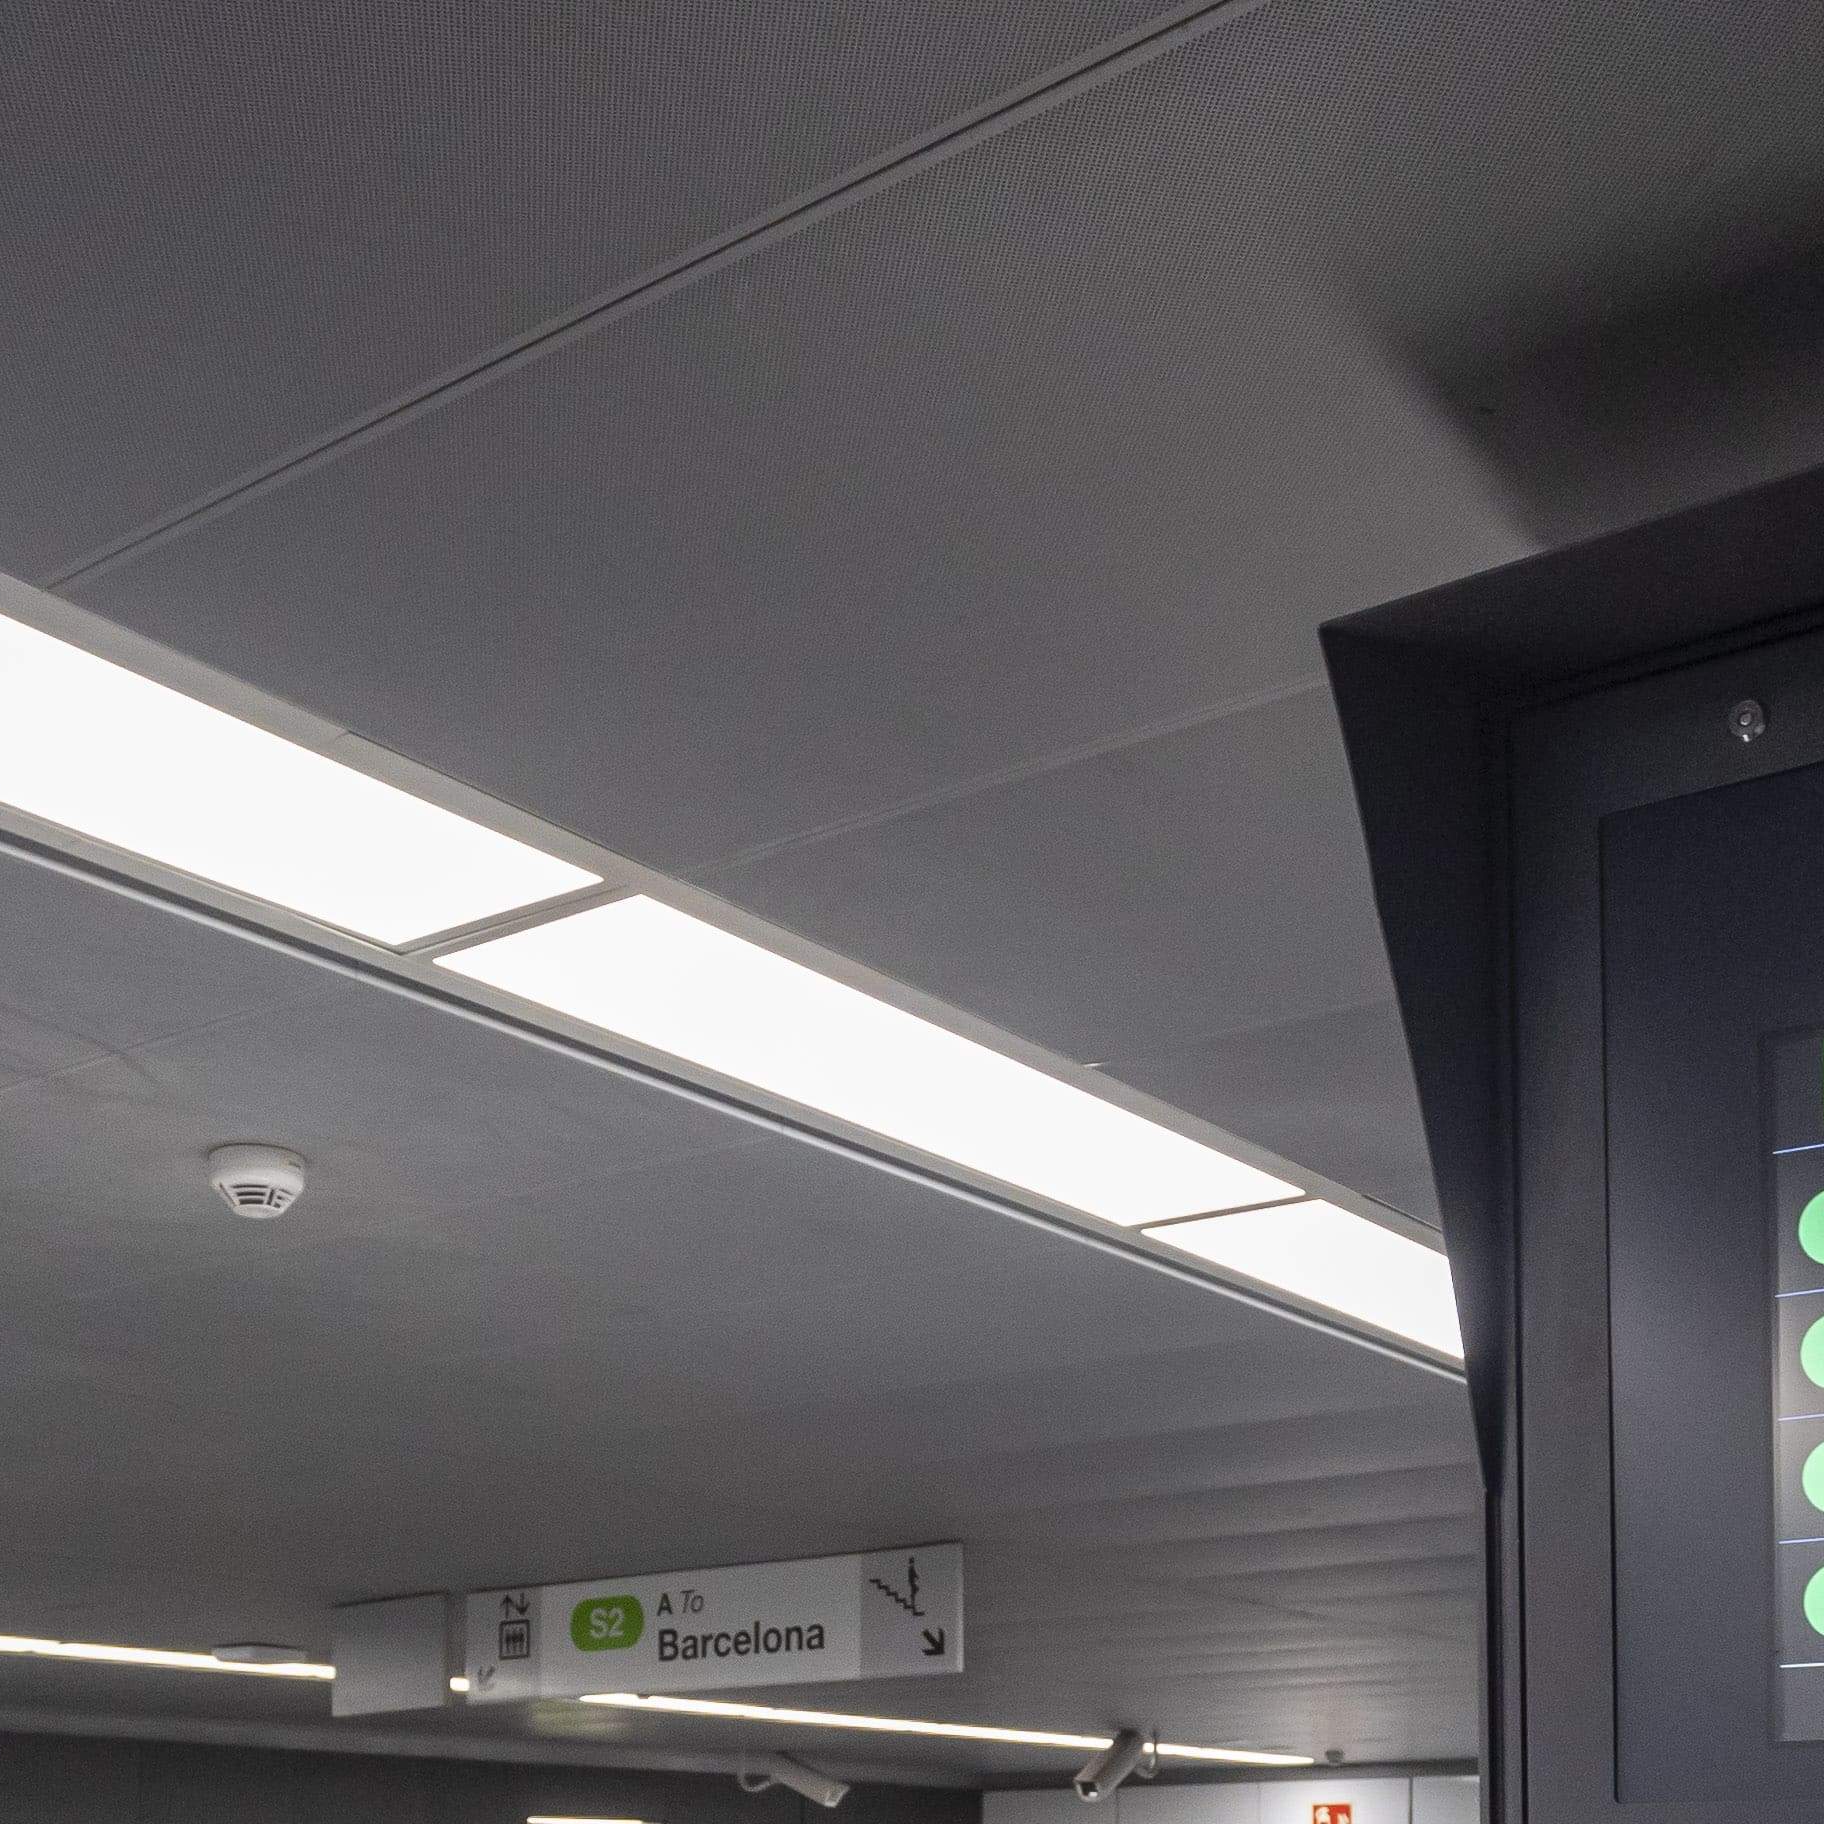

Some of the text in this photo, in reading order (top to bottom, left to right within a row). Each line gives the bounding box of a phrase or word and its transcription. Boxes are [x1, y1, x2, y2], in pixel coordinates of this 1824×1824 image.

[656, 1589, 705, 1617] A To
[589, 1606, 626, 1640] S2
[658, 1620, 825, 1663] Barcelona
